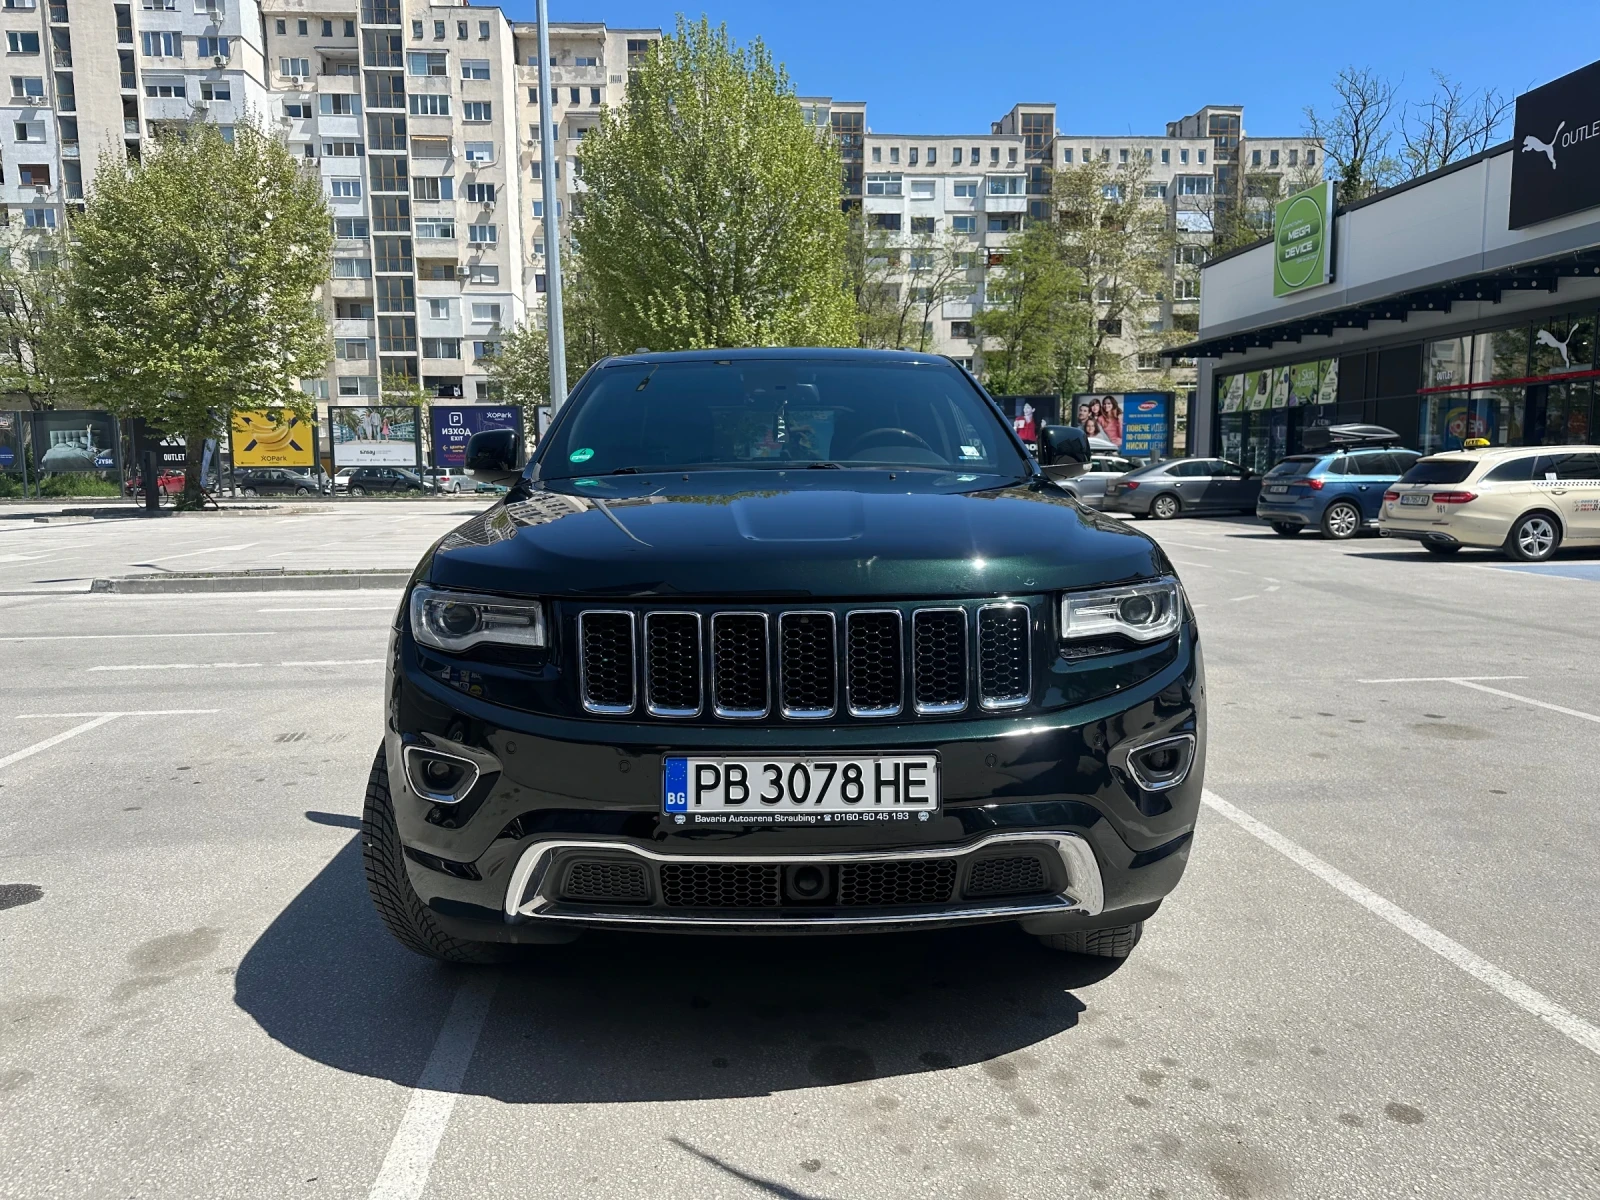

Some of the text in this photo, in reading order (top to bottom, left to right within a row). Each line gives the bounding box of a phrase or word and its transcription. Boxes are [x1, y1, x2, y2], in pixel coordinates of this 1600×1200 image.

[1288, 224, 1311, 241] MEGA
[1285, 241, 1313, 258] DEVICE
[1301, 368, 1315, 380] Skin
[1436, 370, 1453, 380] OUTLET
[453, 415, 459, 423] P
[441, 427, 472, 436] ИЗХОД
[1127, 424, 1150, 432] ПОВЕЧЕ
[1126, 441, 1149, 450] НИСКИ
[163, 453, 185, 461] OUTLET
[694, 762, 929, 805] PB 3078 HE
[667, 792, 686, 804] BG
[695, 814, 727, 823] Bavaria
[728, 814, 773, 823] Autoarena
[774, 814, 816, 824] Straubing
[834, 812, 875, 821] 0160-60
[877, 812, 889, 821] 45
[892, 812, 909, 820] 193
